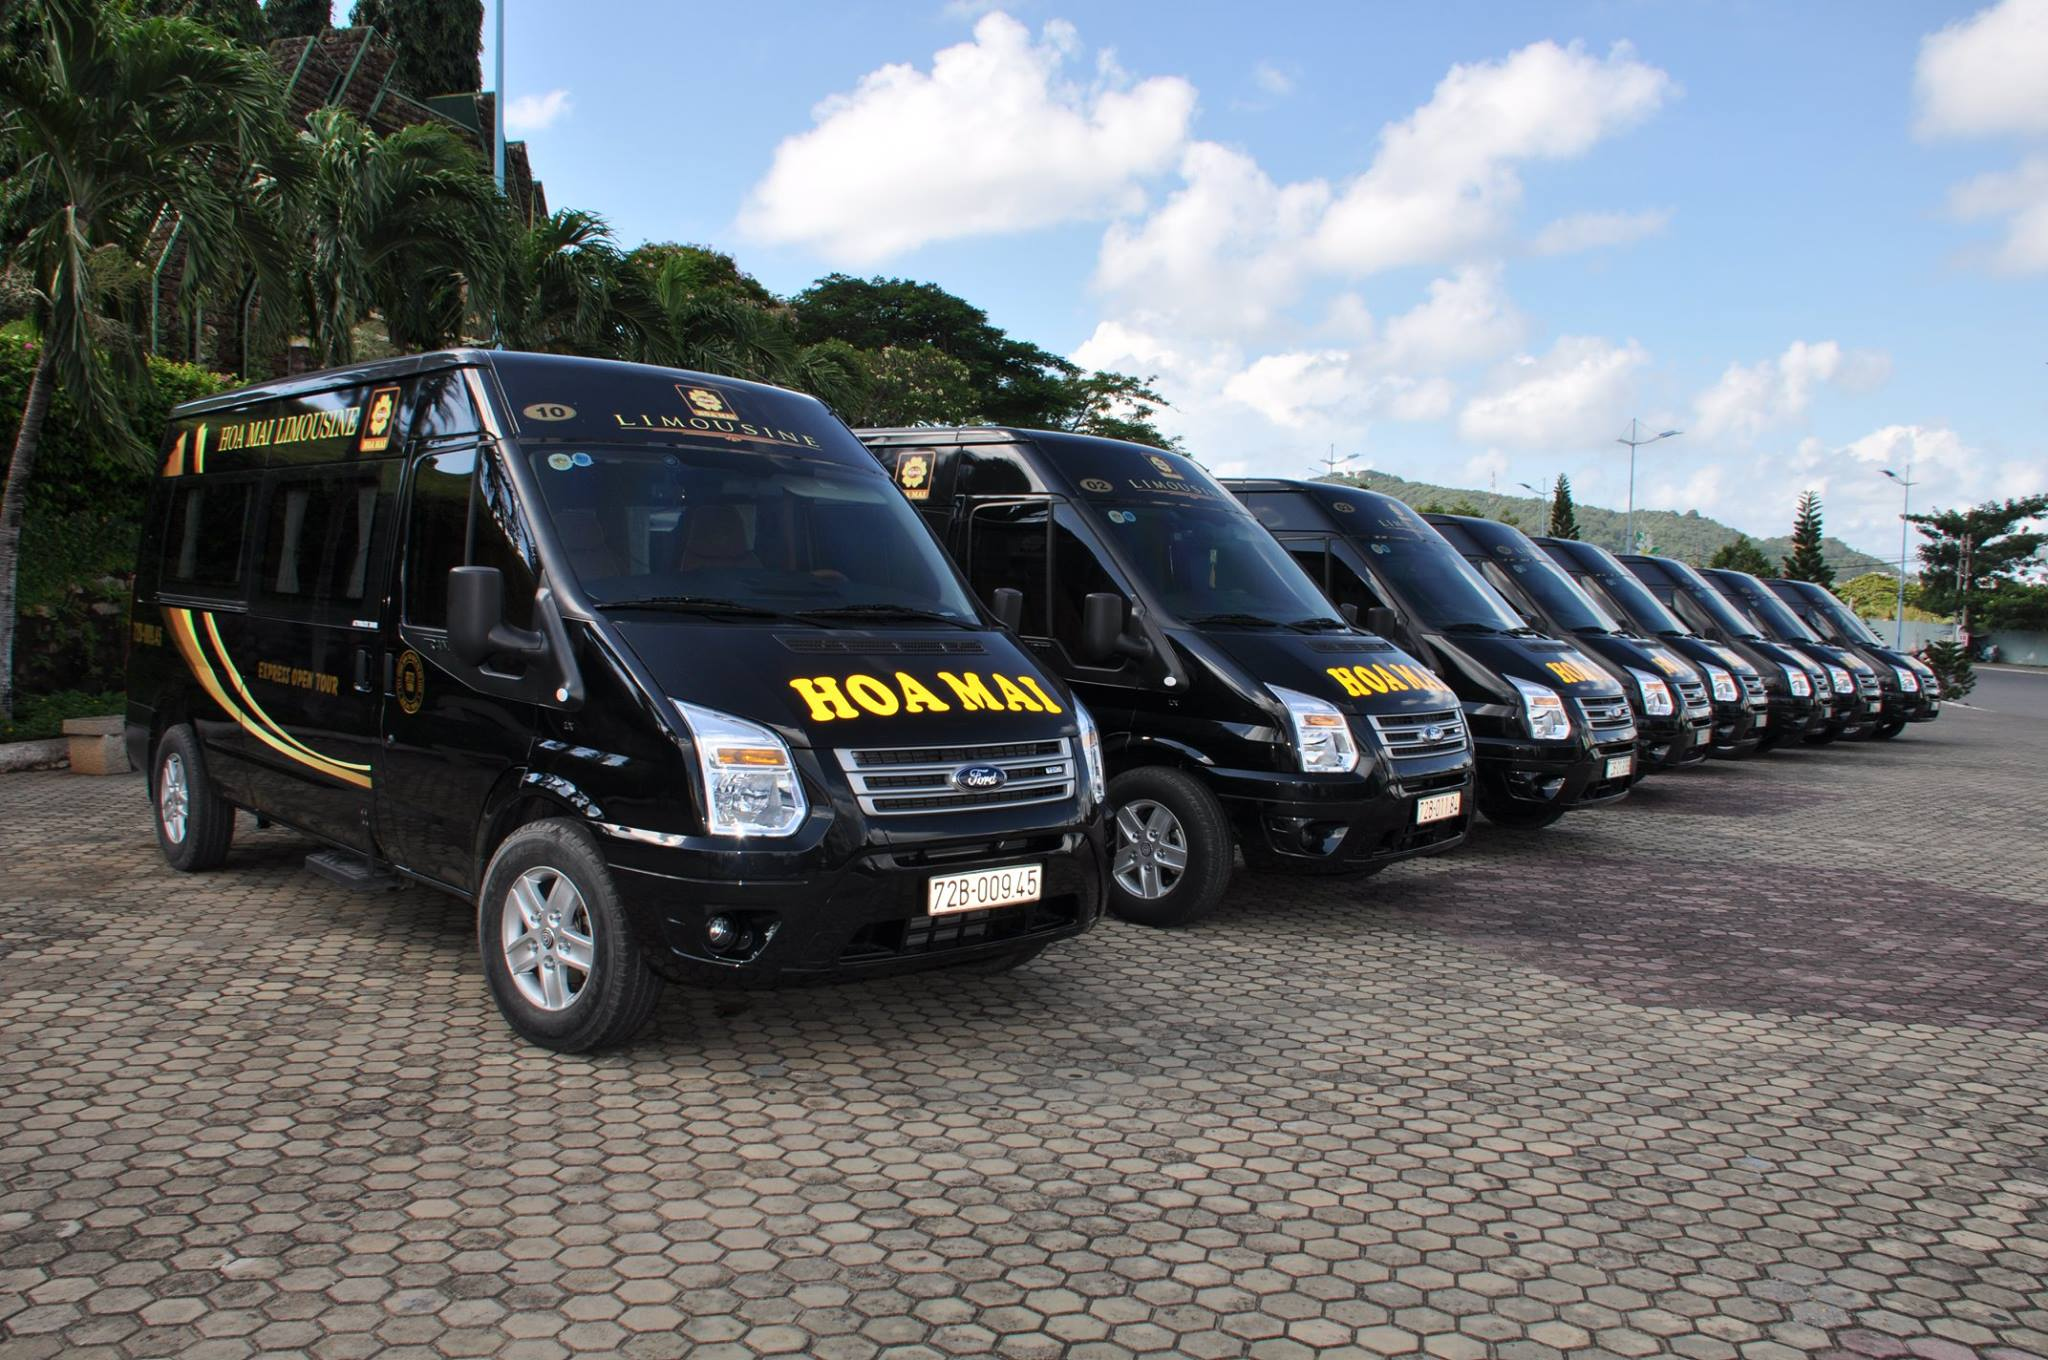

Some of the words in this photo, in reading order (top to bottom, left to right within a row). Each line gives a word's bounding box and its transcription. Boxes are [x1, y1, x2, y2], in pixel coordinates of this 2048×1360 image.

[218, 424, 245, 451] HOA
[245, 419, 275, 448] MAI
[274, 407, 360, 444] LIMOUSINE
[535, 406, 565, 418] 10
[616, 414, 820, 448] LIMOUSINE
[1086, 480, 1108, 491] 02
[258, 662, 291, 684] EXPRESS
[290, 667, 314, 689] OPEN
[315, 672, 340, 697] TOUR
[789, 671, 952, 721] HOA
[938, 671, 1063, 715] MAI
[1326, 664, 1409, 697] HOA
[967, 768, 998, 787] Ford
[932, 867, 1038, 909] 72B-009.45
